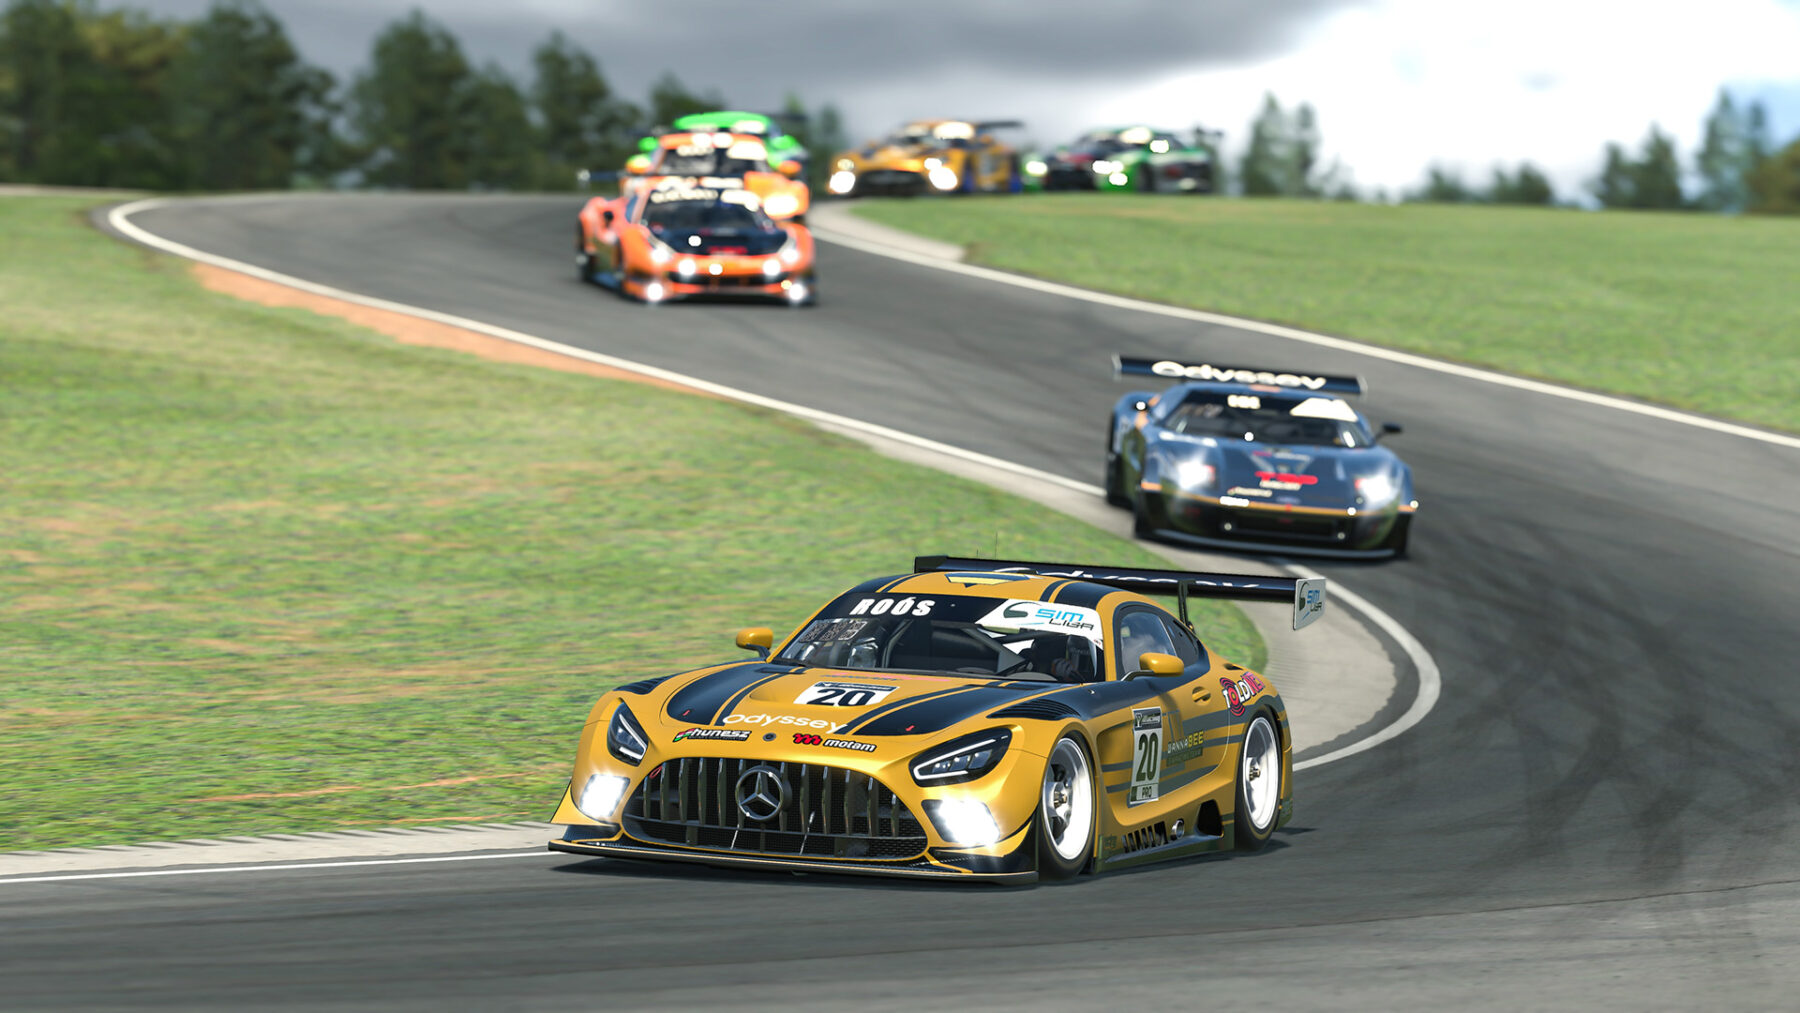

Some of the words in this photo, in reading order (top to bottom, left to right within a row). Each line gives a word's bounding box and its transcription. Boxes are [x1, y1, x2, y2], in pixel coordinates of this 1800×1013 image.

[849, 597, 936, 616] ROÓS
[1035, 608, 1084, 622] SIM
[1049, 618, 1095, 631] LIGA
[806, 688, 876, 706] 20
[824, 739, 876, 752] motam
[1136, 732, 1159, 782] 20
[1141, 786, 1153, 798] PRO
